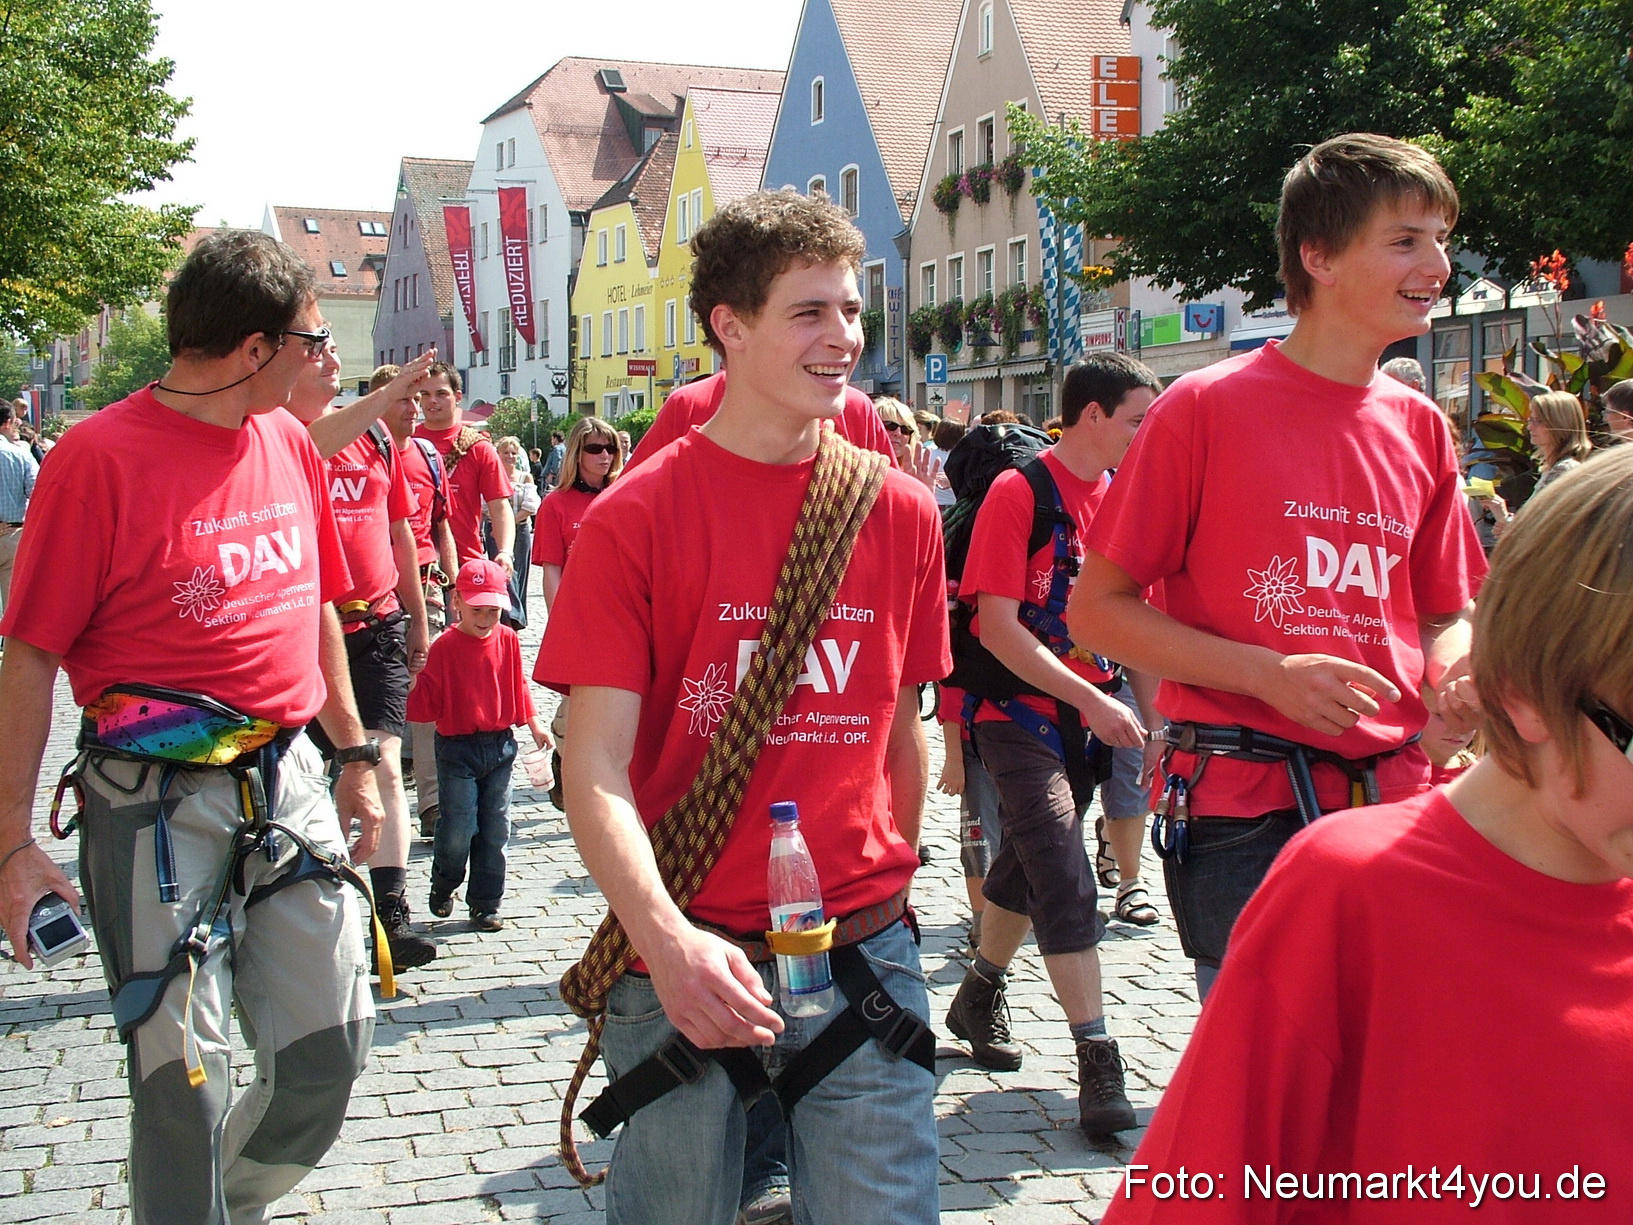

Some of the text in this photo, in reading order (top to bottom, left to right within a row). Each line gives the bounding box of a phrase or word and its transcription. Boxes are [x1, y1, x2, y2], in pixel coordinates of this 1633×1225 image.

[1100, 57, 1119, 141] ELE
[607, 285, 627, 305] HOTEL
[888, 302, 900, 360] WITTL
[1085, 332, 1112, 347] SIMPSONS
[930, 358, 943, 380] P
[330, 476, 368, 502] AV
[192, 502, 298, 537] Zukunft schützen
[1284, 500, 1351, 524] Zukunft
[218, 526, 302, 588] DAV
[1305, 535, 1403, 600] DAV
[204, 612, 247, 628] Sektion
[718, 602, 770, 621] Zuku
[1283, 623, 1329, 636] Sektion
[805, 711, 870, 727] Alpenverein
[766, 730, 822, 745] Neumarkt
[844, 732, 870, 744] OPf.
